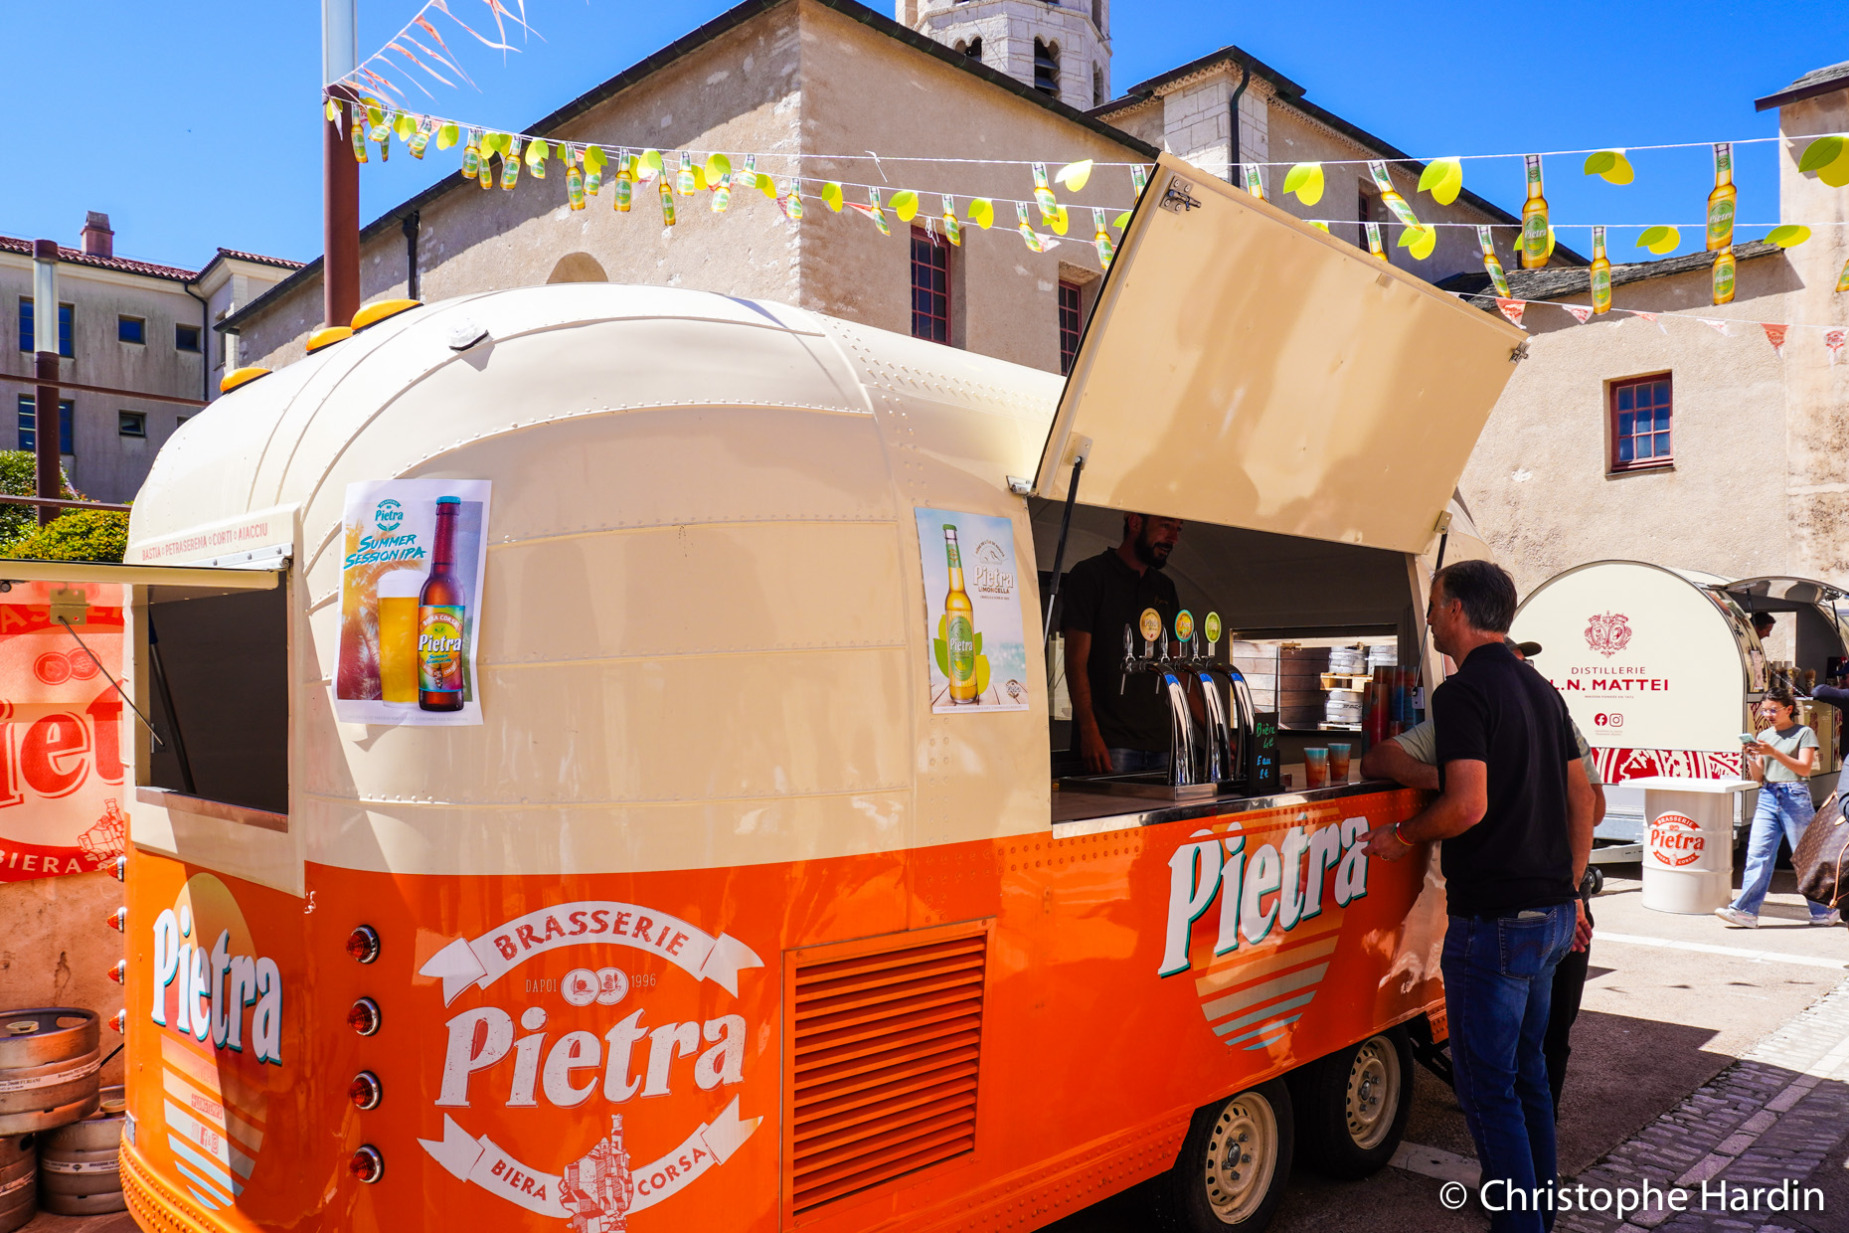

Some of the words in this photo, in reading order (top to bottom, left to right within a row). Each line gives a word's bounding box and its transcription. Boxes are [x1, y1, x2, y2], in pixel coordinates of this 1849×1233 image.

[374, 509, 404, 521] Pietra
[142, 546, 161, 561] BASTIA
[213, 530, 233, 546] CORTI
[238, 522, 268, 541] AIACCIU
[357, 534, 417, 553] SUMMER
[343, 549, 400, 570] SESSION
[400, 546, 428, 560] IPA
[973, 565, 1014, 589] Pietra
[978, 586, 1010, 594] LIMONCELLA
[418, 634, 463, 652] Pietra
[950, 638, 973, 651] Pietra
[1571, 666, 1646, 675] DISTILLERIE
[1592, 679, 1669, 691] MATTEI
[1657, 816, 1693, 826] BRASSERIE
[1650, 829, 1705, 851] Pietra
[1158, 812, 1370, 978] Pietra
[493, 910, 690, 961] BRASSERIE
[151, 904, 282, 1066] Pietra
[525, 978, 557, 993] DAPOI
[631, 973, 657, 988] 1996
[434, 1006, 748, 1110] Pietra
[490, 1159, 547, 1201] BIERA
[637, 1147, 707, 1196] CORSA
